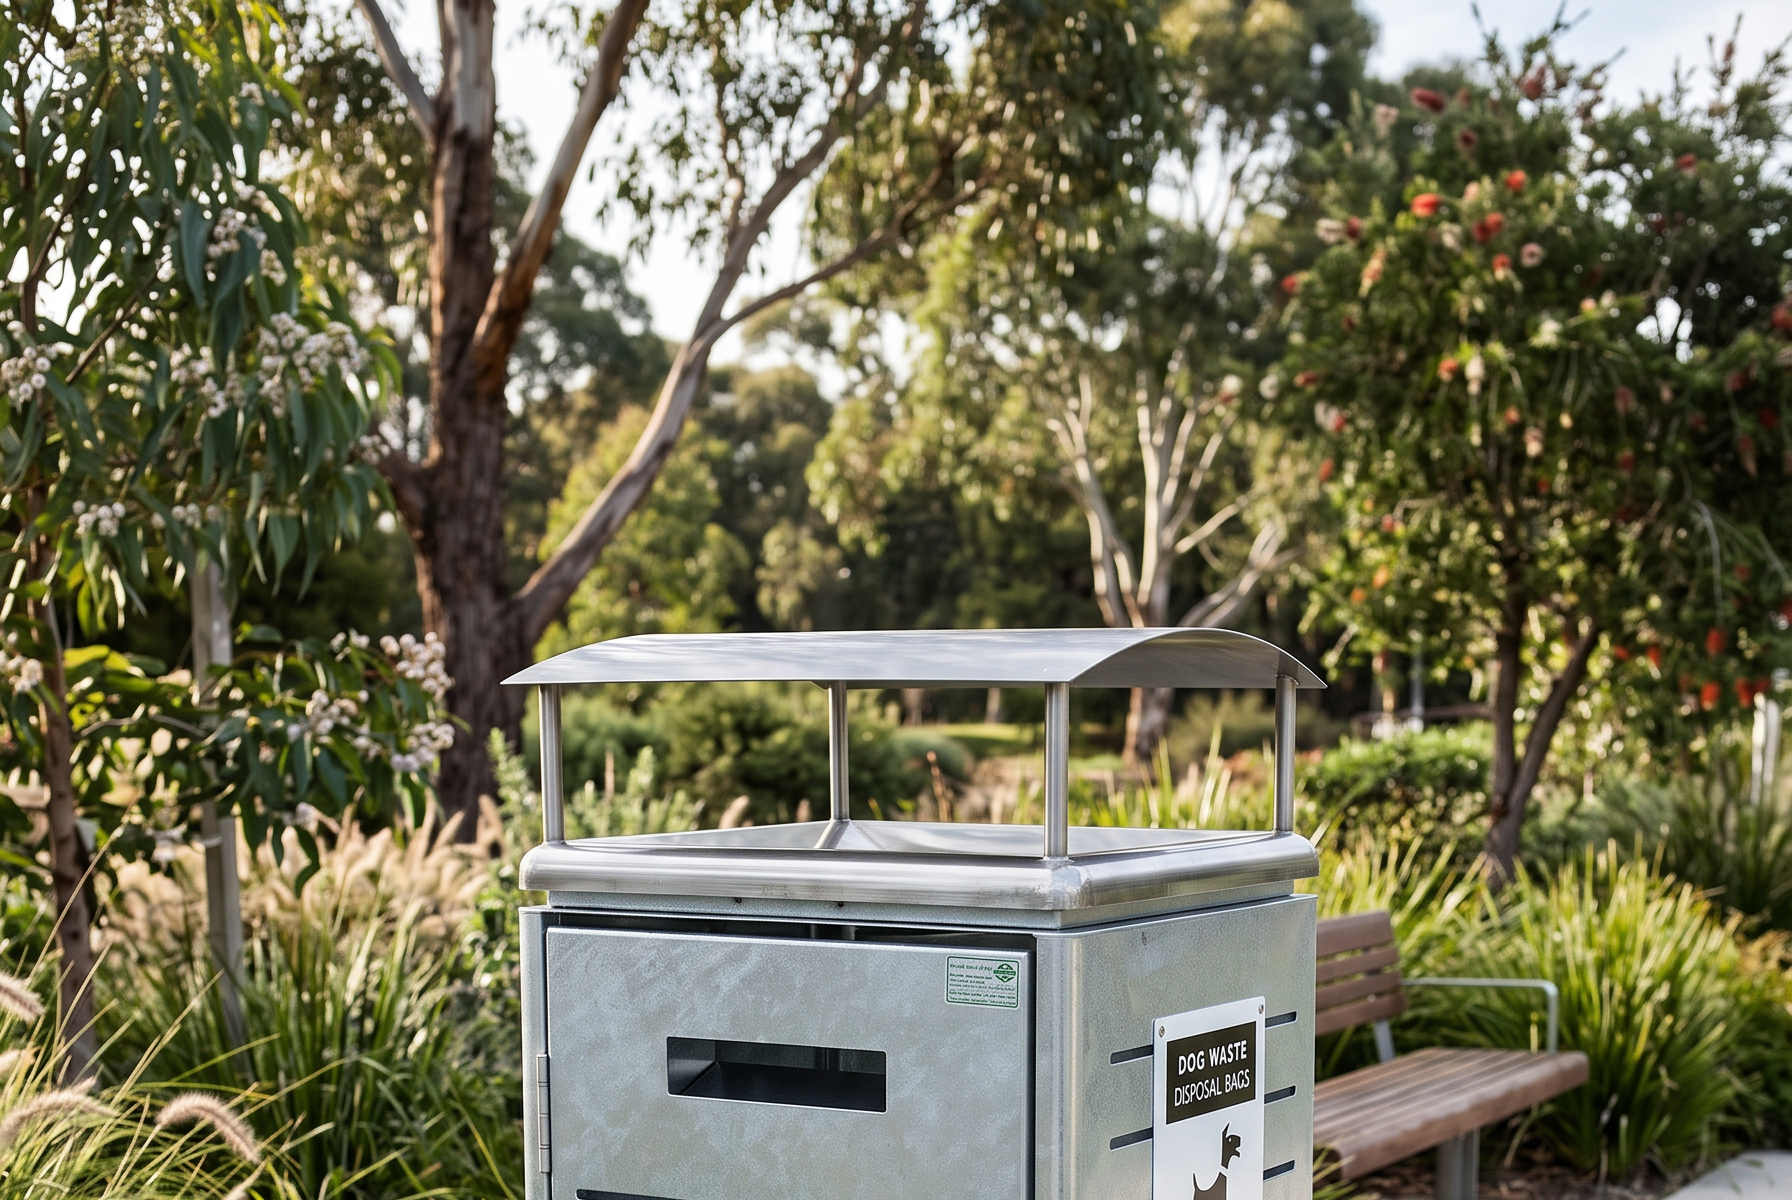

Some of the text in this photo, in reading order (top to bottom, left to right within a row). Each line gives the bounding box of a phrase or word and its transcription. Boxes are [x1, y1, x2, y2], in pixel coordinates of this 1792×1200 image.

[1179, 1040, 1247, 1075] DOG WASTE
[1174, 1068, 1250, 1107] DISPOSAL BAGS
